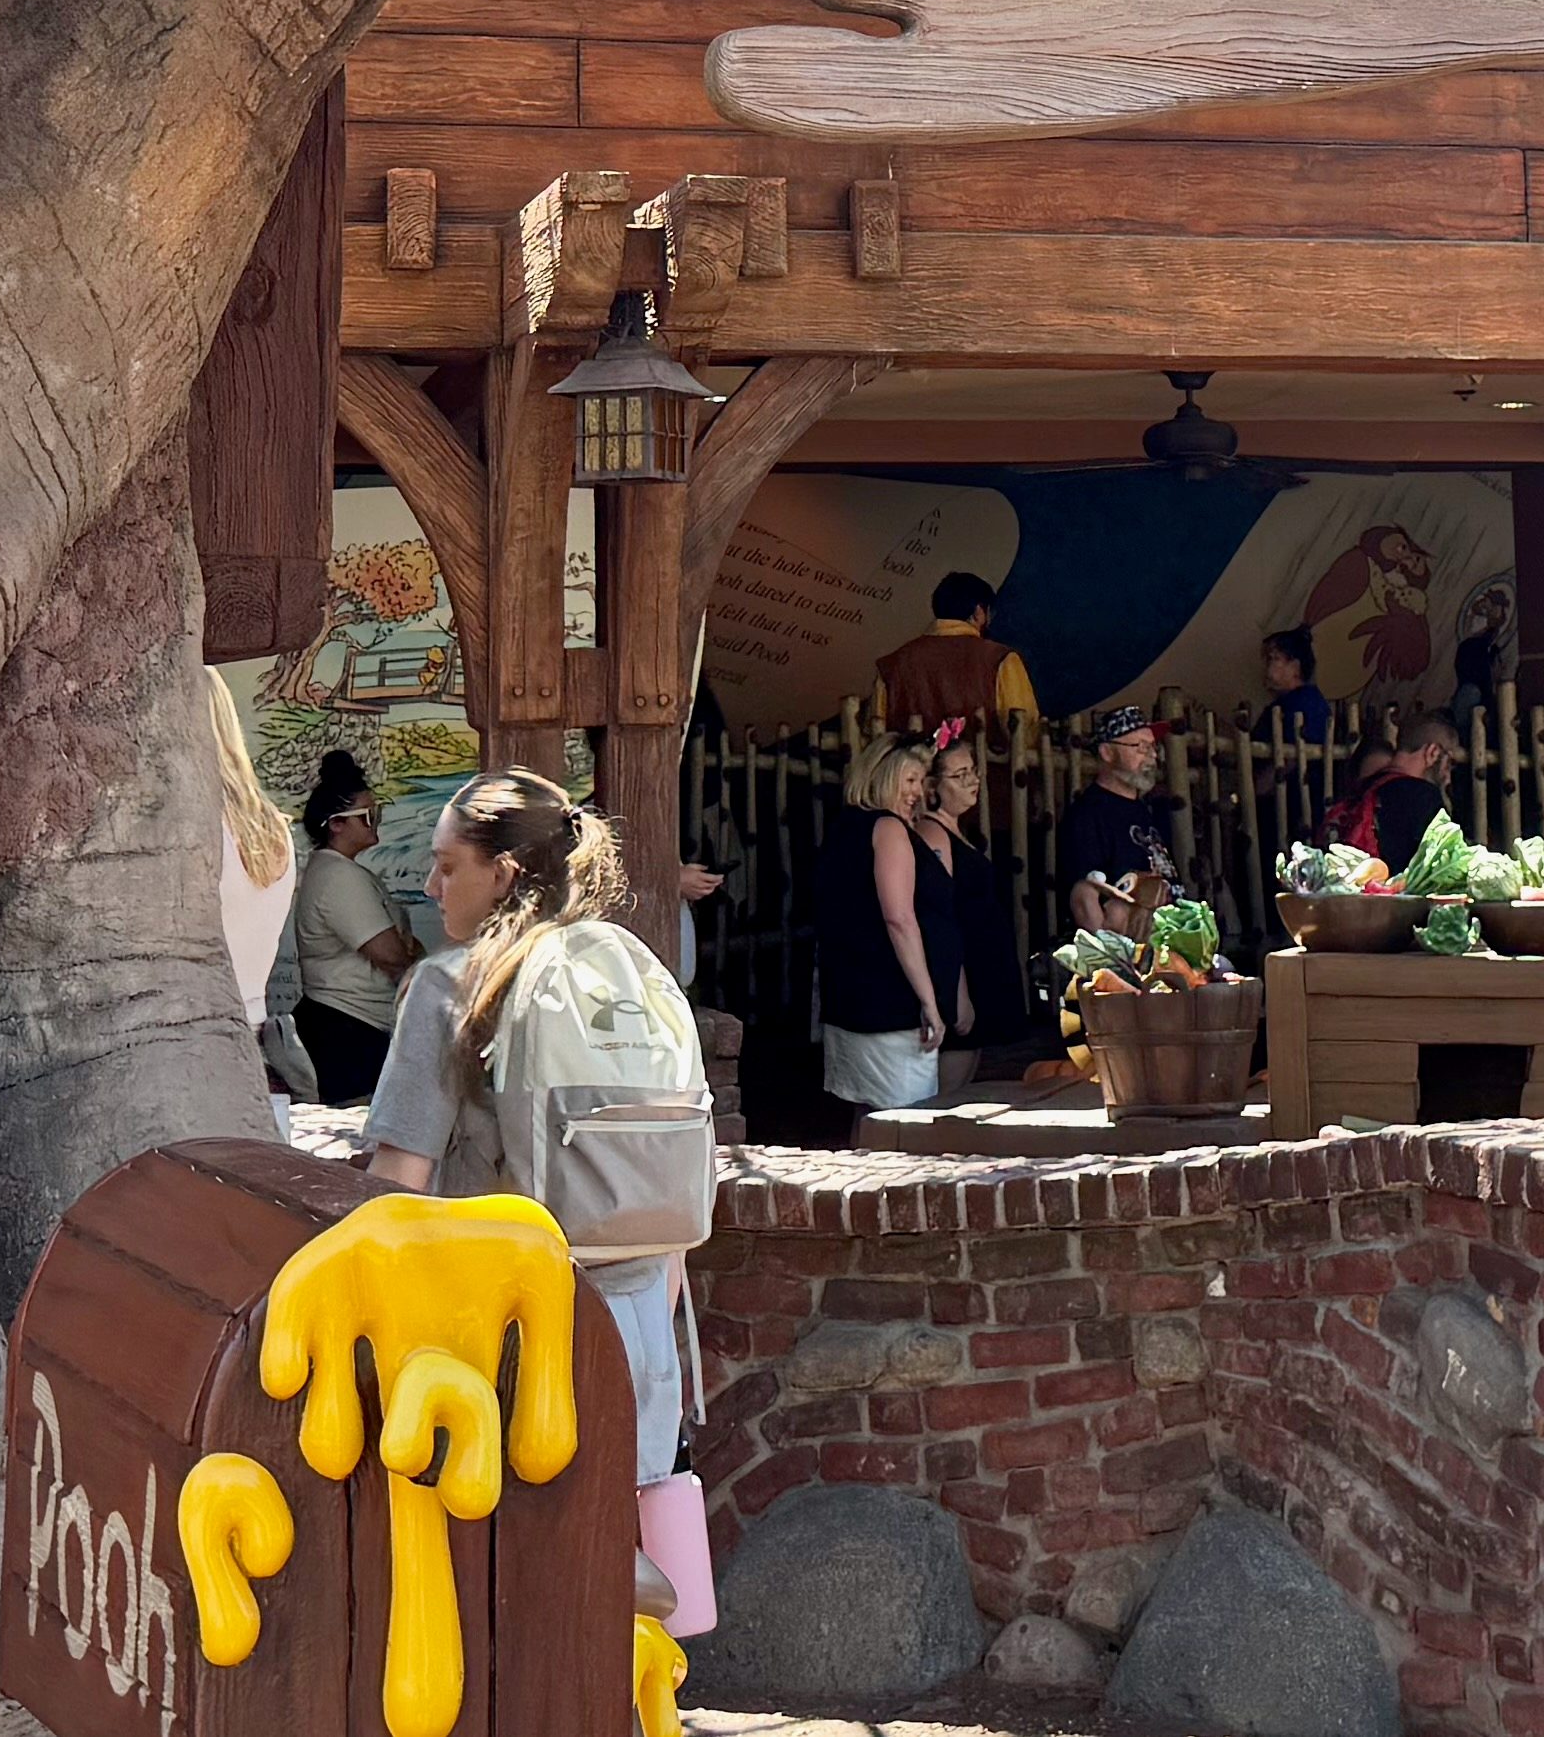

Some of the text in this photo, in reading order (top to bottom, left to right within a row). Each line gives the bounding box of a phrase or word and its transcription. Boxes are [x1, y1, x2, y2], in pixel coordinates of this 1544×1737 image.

[742, 547, 772, 567] the
[772, 556, 810, 578] hole
[813, 569, 843, 588] was
[845, 582, 893, 603] much
[744, 579, 797, 605] dared
[793, 595, 814, 610] to
[716, 603, 749, 624] felt
[747, 612, 783, 633] that
[782, 622, 799, 638] it
[800, 630, 832, 647] was
[746, 641, 791, 666] Pooh
[27, 1371, 178, 1737] Pooh
